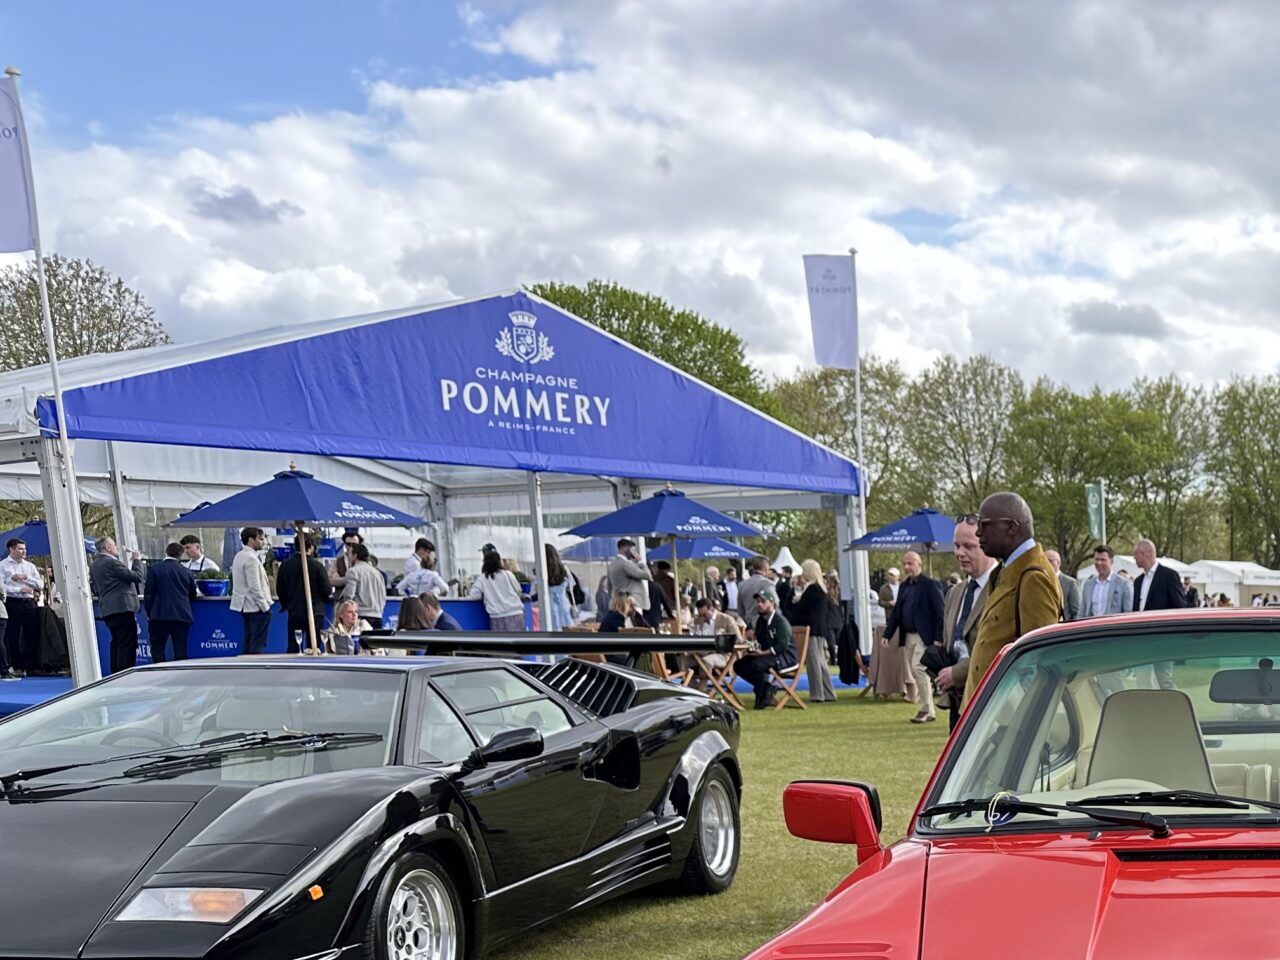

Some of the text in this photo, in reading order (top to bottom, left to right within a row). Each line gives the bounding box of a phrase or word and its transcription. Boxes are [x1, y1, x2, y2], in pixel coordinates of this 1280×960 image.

[475, 366, 579, 389] CHAMPAGNE
[440, 378, 611, 427] POMMERY
[498, 421, 576, 435] REIMS-FRANCE
[334, 510, 396, 521] POMMERY
[675, 524, 732, 532] POMMERY
[200, 641, 238, 649] POMMERY
